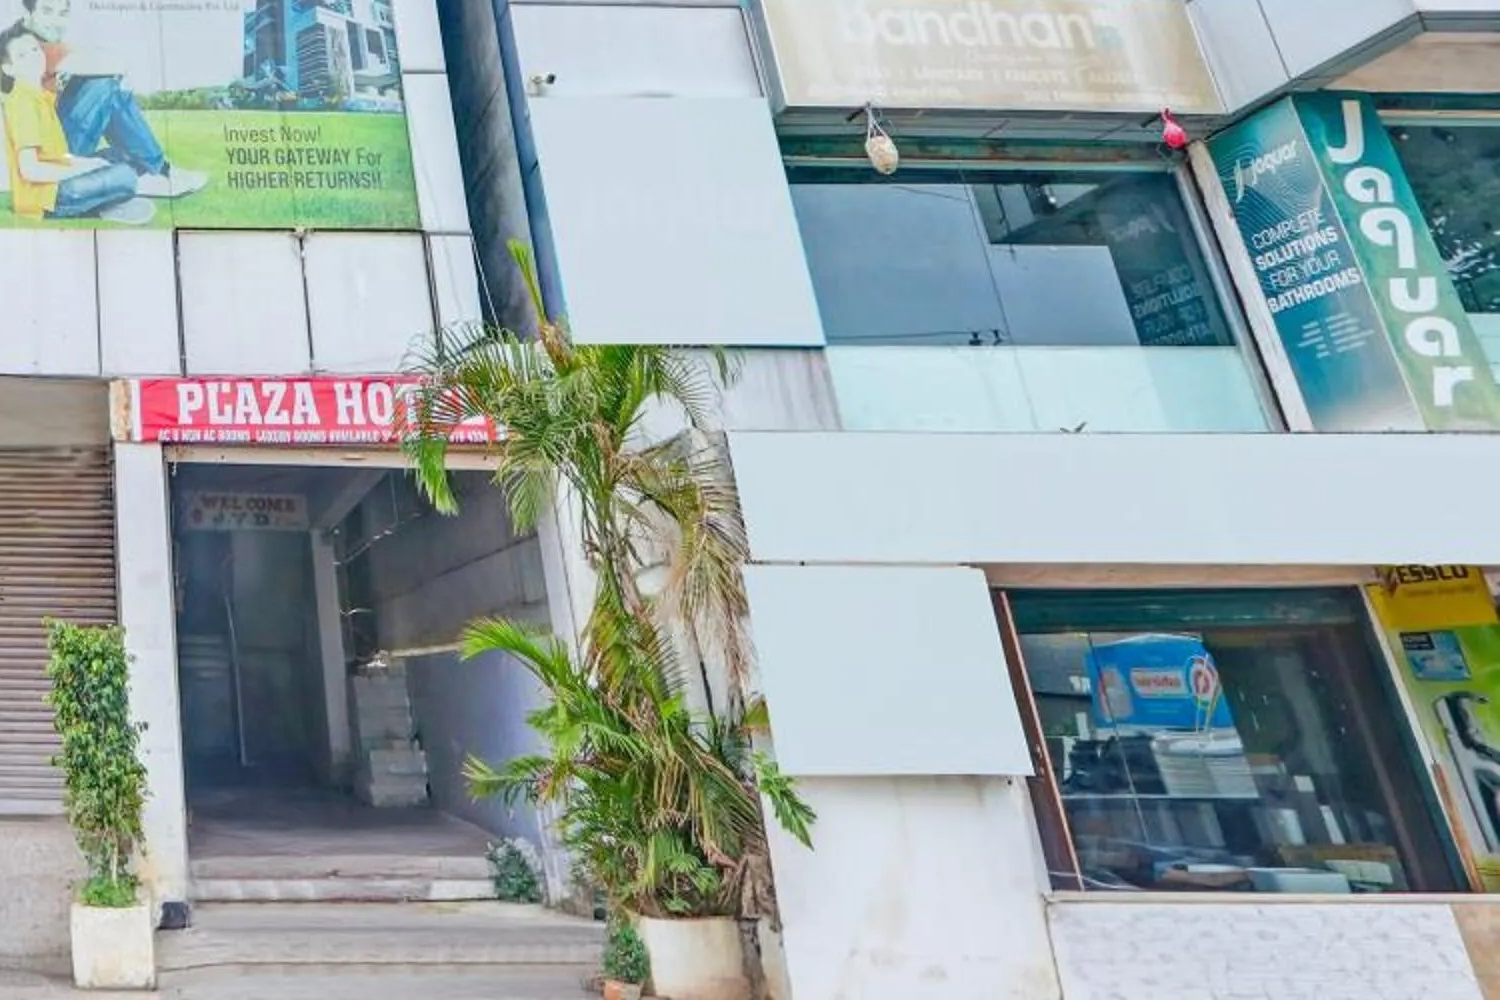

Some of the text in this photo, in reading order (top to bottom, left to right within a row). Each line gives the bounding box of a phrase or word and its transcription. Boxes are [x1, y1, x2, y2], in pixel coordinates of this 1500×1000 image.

[223, 124, 321, 143] Invest Now!
[226, 148, 382, 166] YOUR GATEWAY For
[228, 171, 382, 189] HIGHER RETURNS!!
[1251, 207, 1326, 250] COMPLETE
[1255, 226, 1339, 271] SOLUTIONS
[1268, 267, 1362, 313] BATHROOMS
[1269, 250, 1342, 291] FOR YOUR
[177, 382, 321, 425] PLAZA
